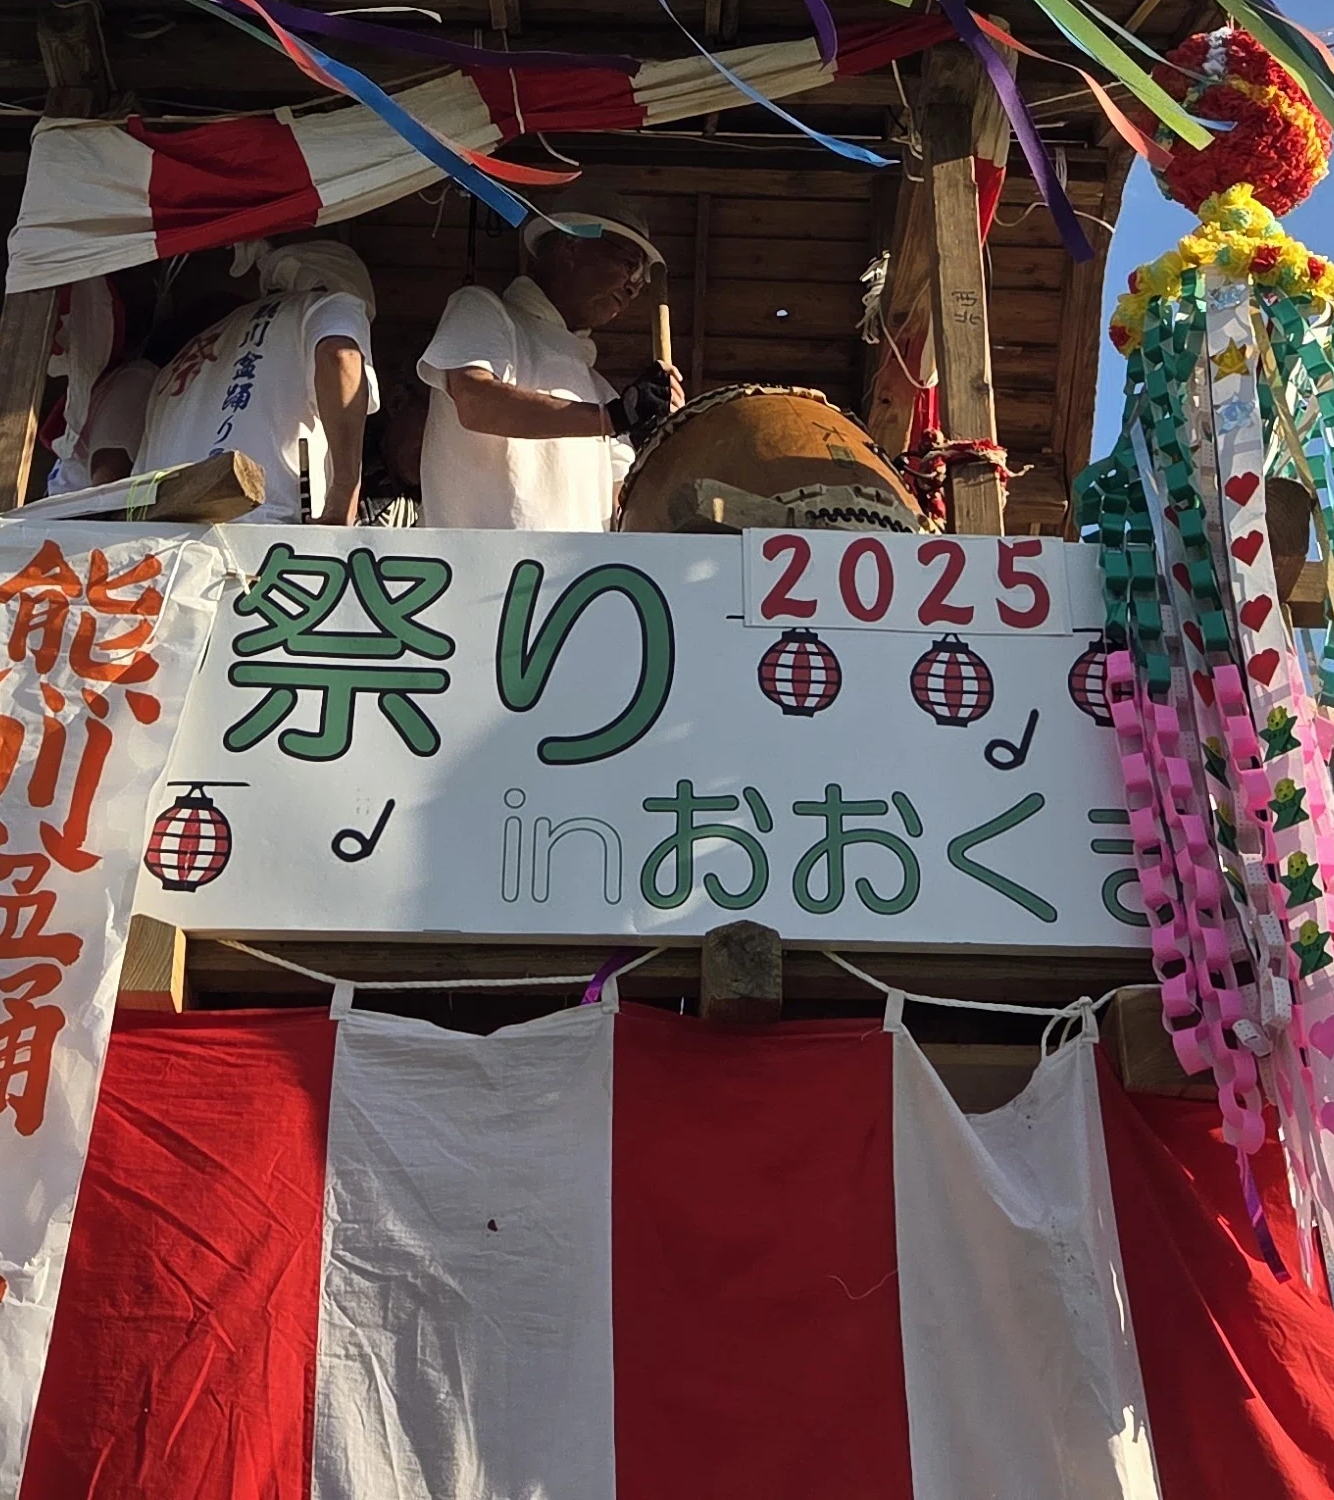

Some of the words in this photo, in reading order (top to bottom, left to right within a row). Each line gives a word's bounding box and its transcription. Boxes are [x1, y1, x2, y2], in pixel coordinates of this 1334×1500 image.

[209, 300, 282, 457] 川盆踊り
[761, 533, 1051, 629] 2025
